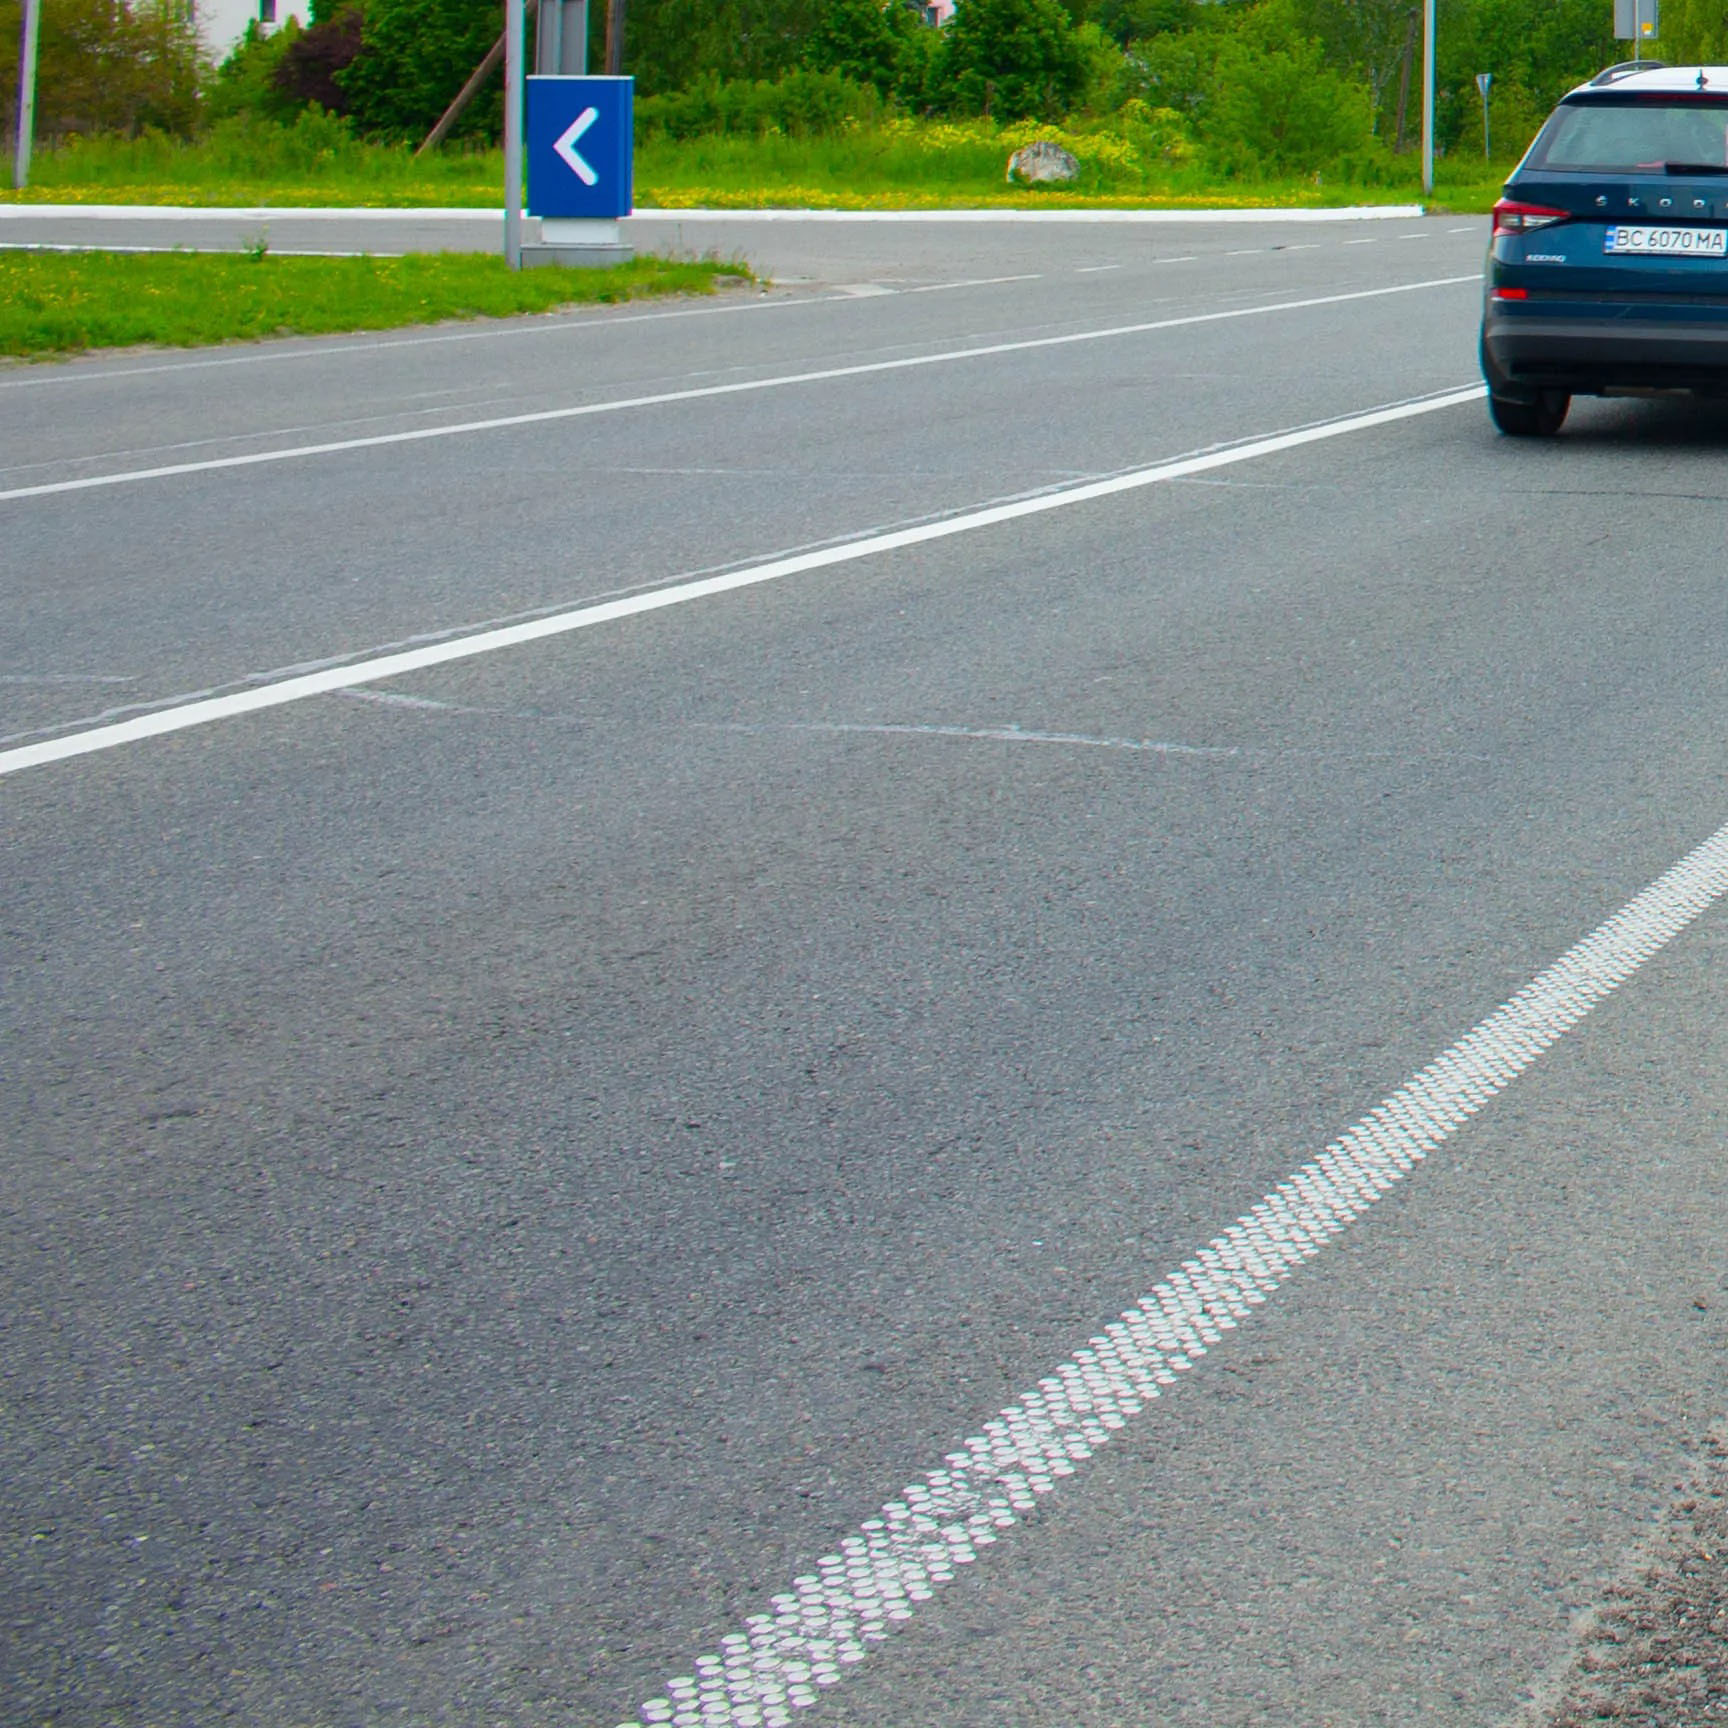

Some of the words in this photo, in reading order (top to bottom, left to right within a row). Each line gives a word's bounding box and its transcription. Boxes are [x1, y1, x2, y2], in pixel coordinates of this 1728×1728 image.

[1616, 229, 1643, 247] BC
[1648, 230, 1693, 249] 6070
[1696, 232, 1724, 250] MA
